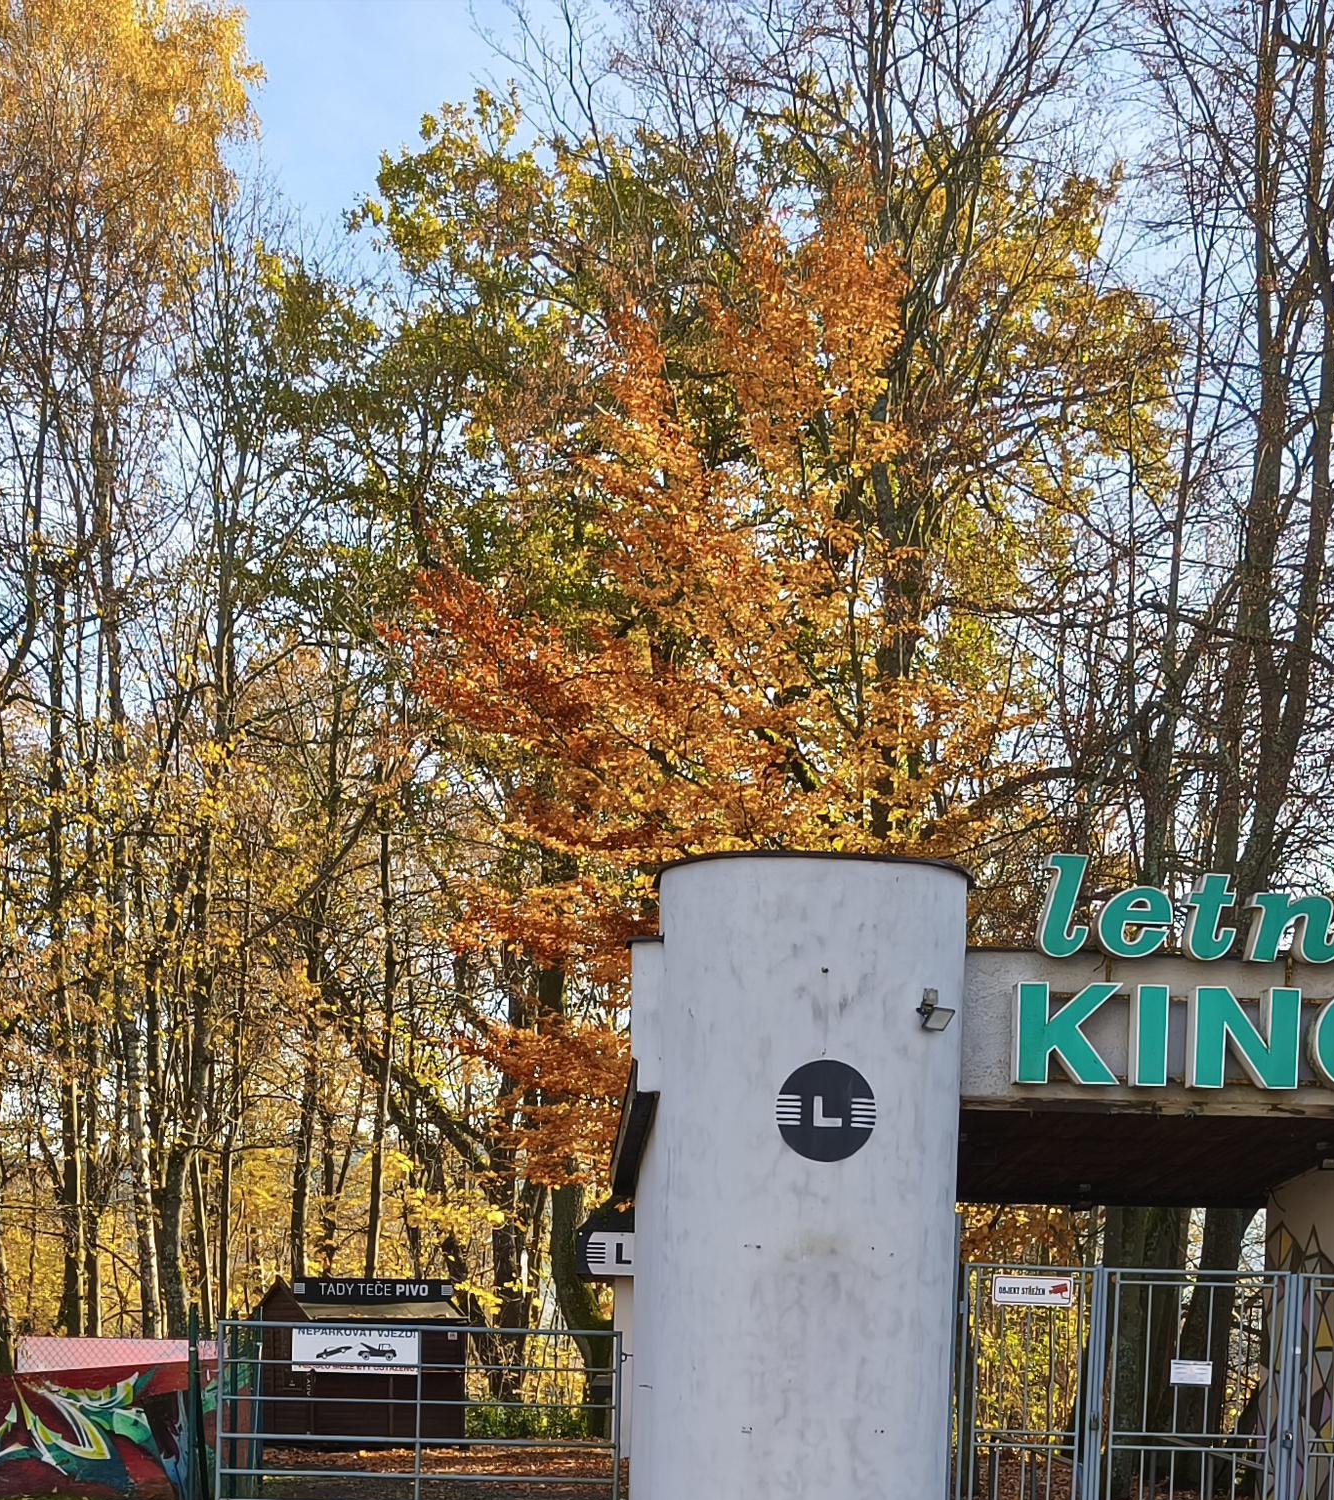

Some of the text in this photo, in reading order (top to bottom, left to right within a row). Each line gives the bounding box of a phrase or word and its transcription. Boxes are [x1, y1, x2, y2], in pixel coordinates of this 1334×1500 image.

[812, 1095, 843, 1129] L
[615, 1242, 632, 1265] L
[318, 1280, 429, 1297] TADY TEČE PIVO
